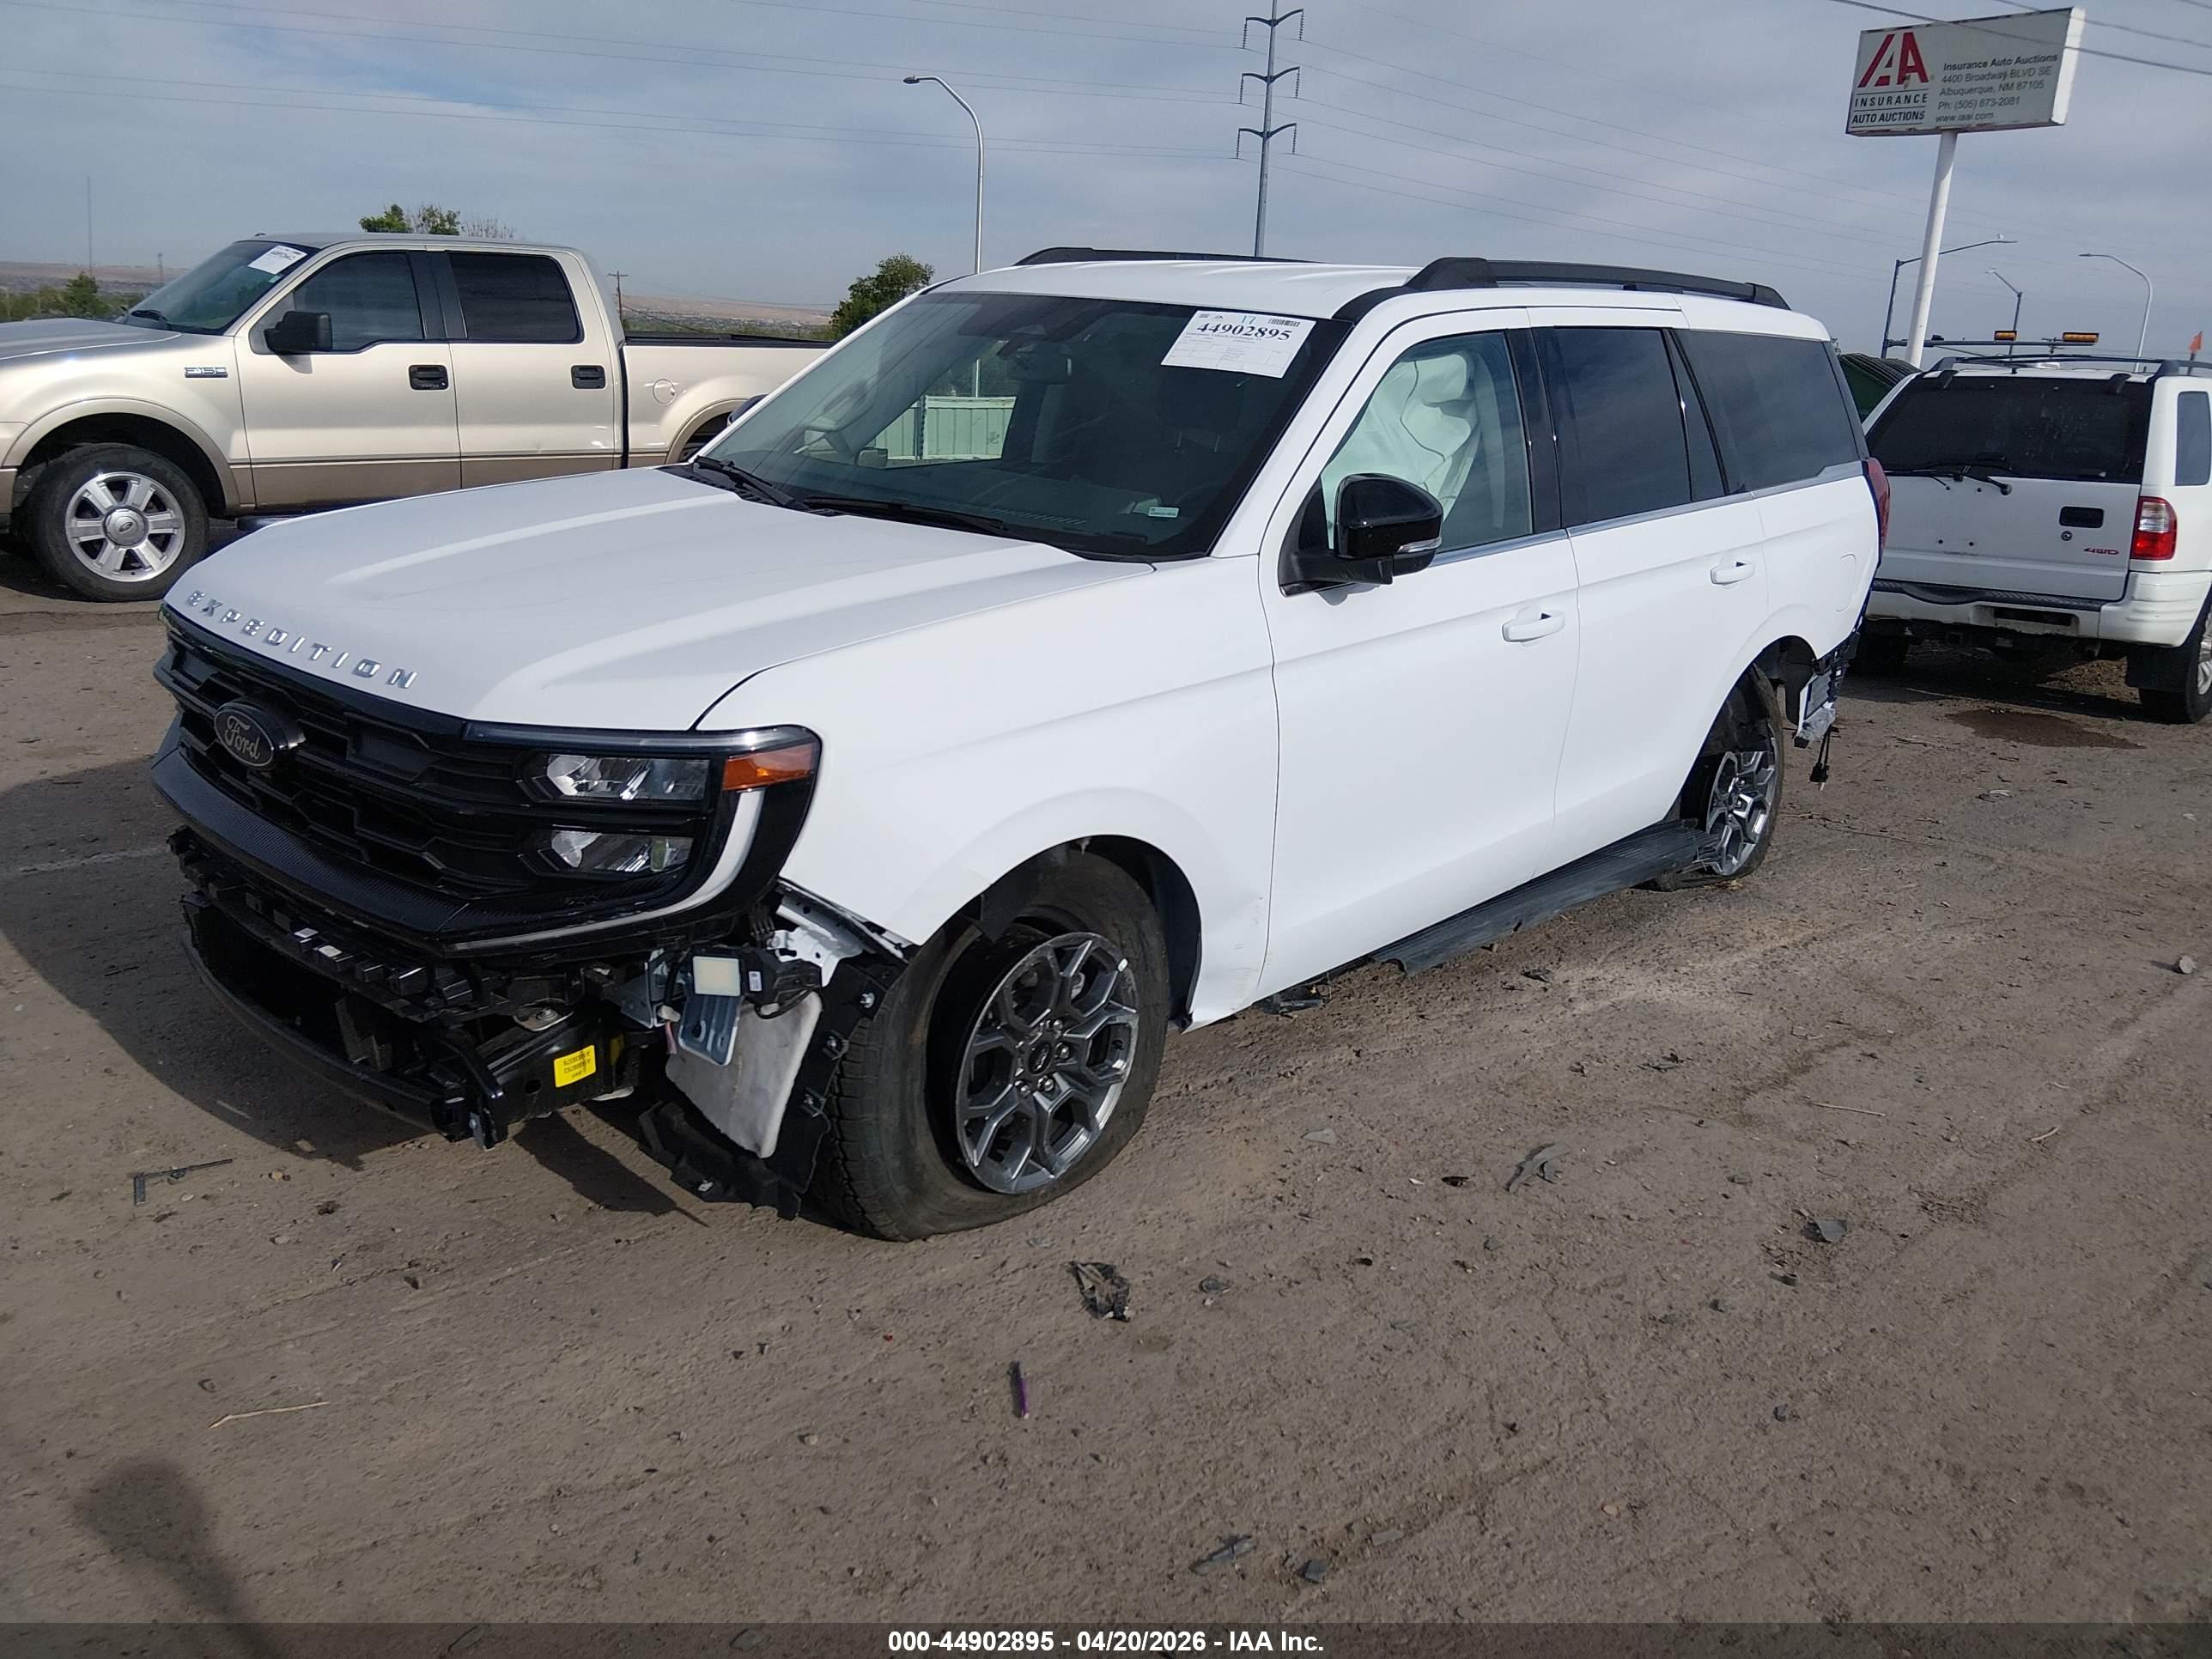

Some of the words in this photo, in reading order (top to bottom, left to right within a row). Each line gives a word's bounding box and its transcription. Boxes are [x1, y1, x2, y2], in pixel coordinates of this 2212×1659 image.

[1943, 60, 1988, 71] Insurance
[1990, 57, 2013, 67] Auto
[2014, 53, 2058, 65] Auctions
[1941, 75, 1963, 83] 4400
[1965, 70, 2008, 82] Broadway
[2009, 67, 2035, 78] BLVD
[2038, 65, 2052, 76] SE
[1998, 82, 2014, 93] NM
[1855, 93, 1928, 107] INSURANCE
[1954, 99, 1978, 111] (505)
[1851, 113, 1877, 125] AUTO
[1878, 110, 1925, 123] AUCTIONS
[1196, 321, 1292, 341] 44902895
[186, 590, 418, 689] EXPEDITION
[226, 714, 261, 761] Ford
